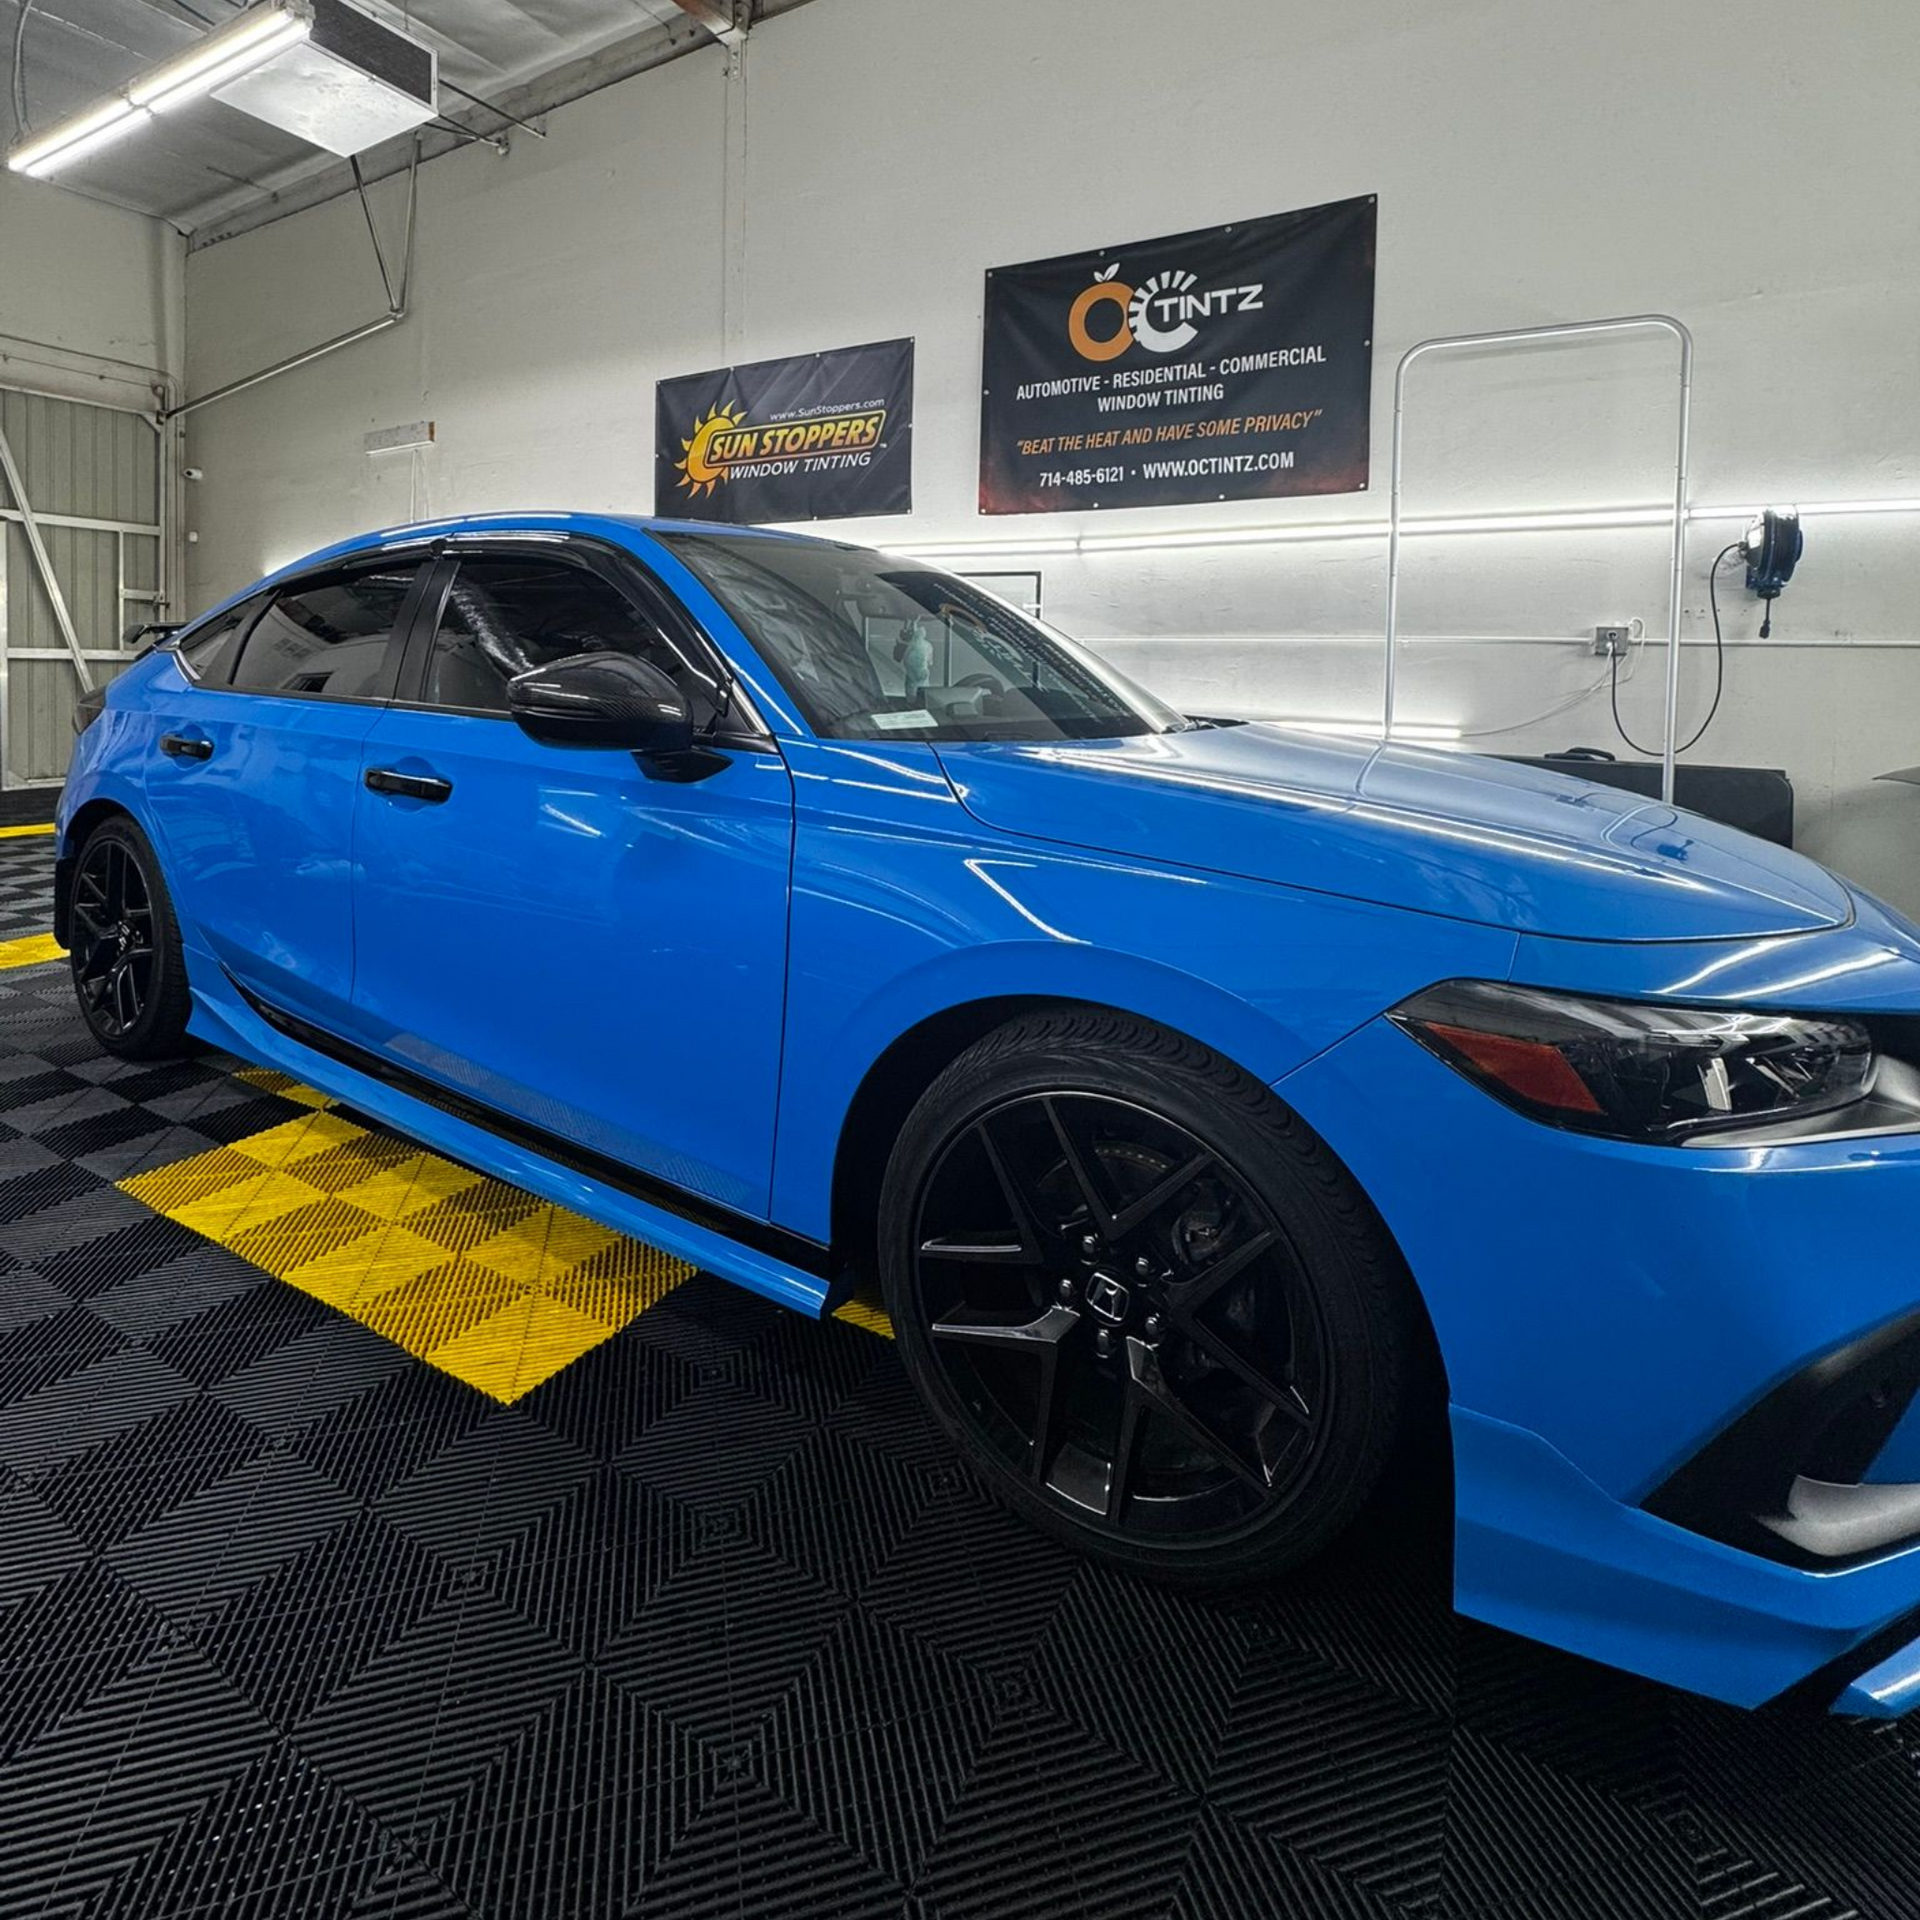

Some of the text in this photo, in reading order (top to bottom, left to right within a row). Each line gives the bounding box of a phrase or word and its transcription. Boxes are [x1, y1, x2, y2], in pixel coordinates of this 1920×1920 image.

[1154, 284, 1263, 322] TINTZ
[1016, 376, 1100, 400] AUTOMOTIVE
[1113, 362, 1206, 388] RESIDENTIAL
[1220, 346, 1327, 374] COMMERCIAL
[770, 399, 884, 421] www.SunStoppers.com
[1097, 384, 1224, 412] WINDOW TINTING
[710, 417, 879, 461] SUN STOPPERS
[1058, 435, 1083, 451] THE
[1085, 431, 1120, 449] HEAT
[1121, 427, 1152, 445] AND
[1155, 423, 1195, 441] HAVE
[1196, 418, 1242, 438] SOME
[730, 452, 871, 479] WINDOW TINTING
[1040, 466, 1123, 487] 714-485-6121
[1143, 451, 1294, 479] WWW.OCTINTZ.COM
